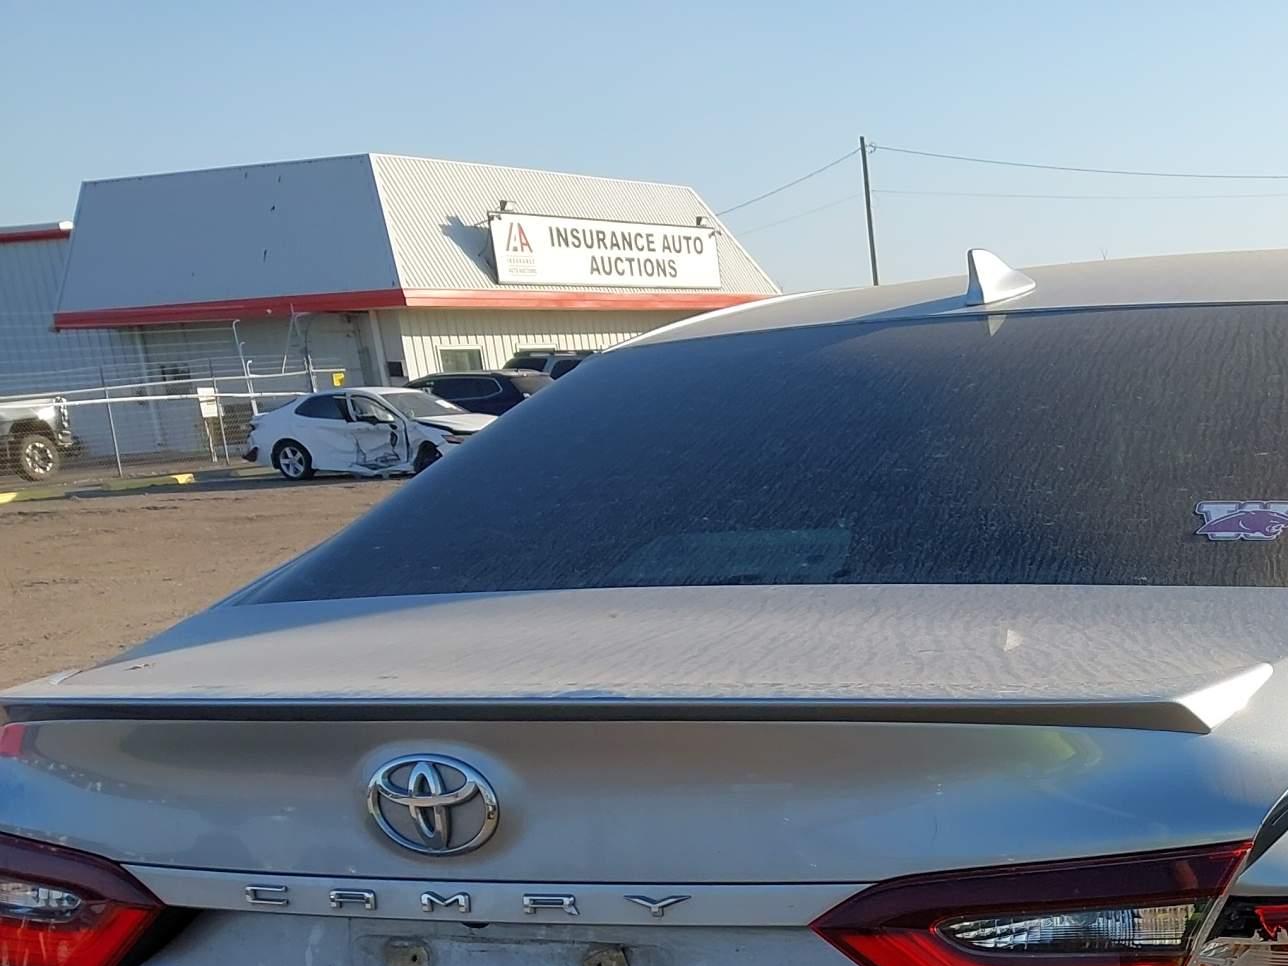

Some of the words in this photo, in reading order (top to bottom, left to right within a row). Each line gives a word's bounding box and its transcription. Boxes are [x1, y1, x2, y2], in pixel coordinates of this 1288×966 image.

[548, 226, 657, 252] INSURANCE
[662, 234, 704, 254] AUTO
[590, 255, 678, 278] AUCTIONS
[245, 885, 692, 918] CAMRY
